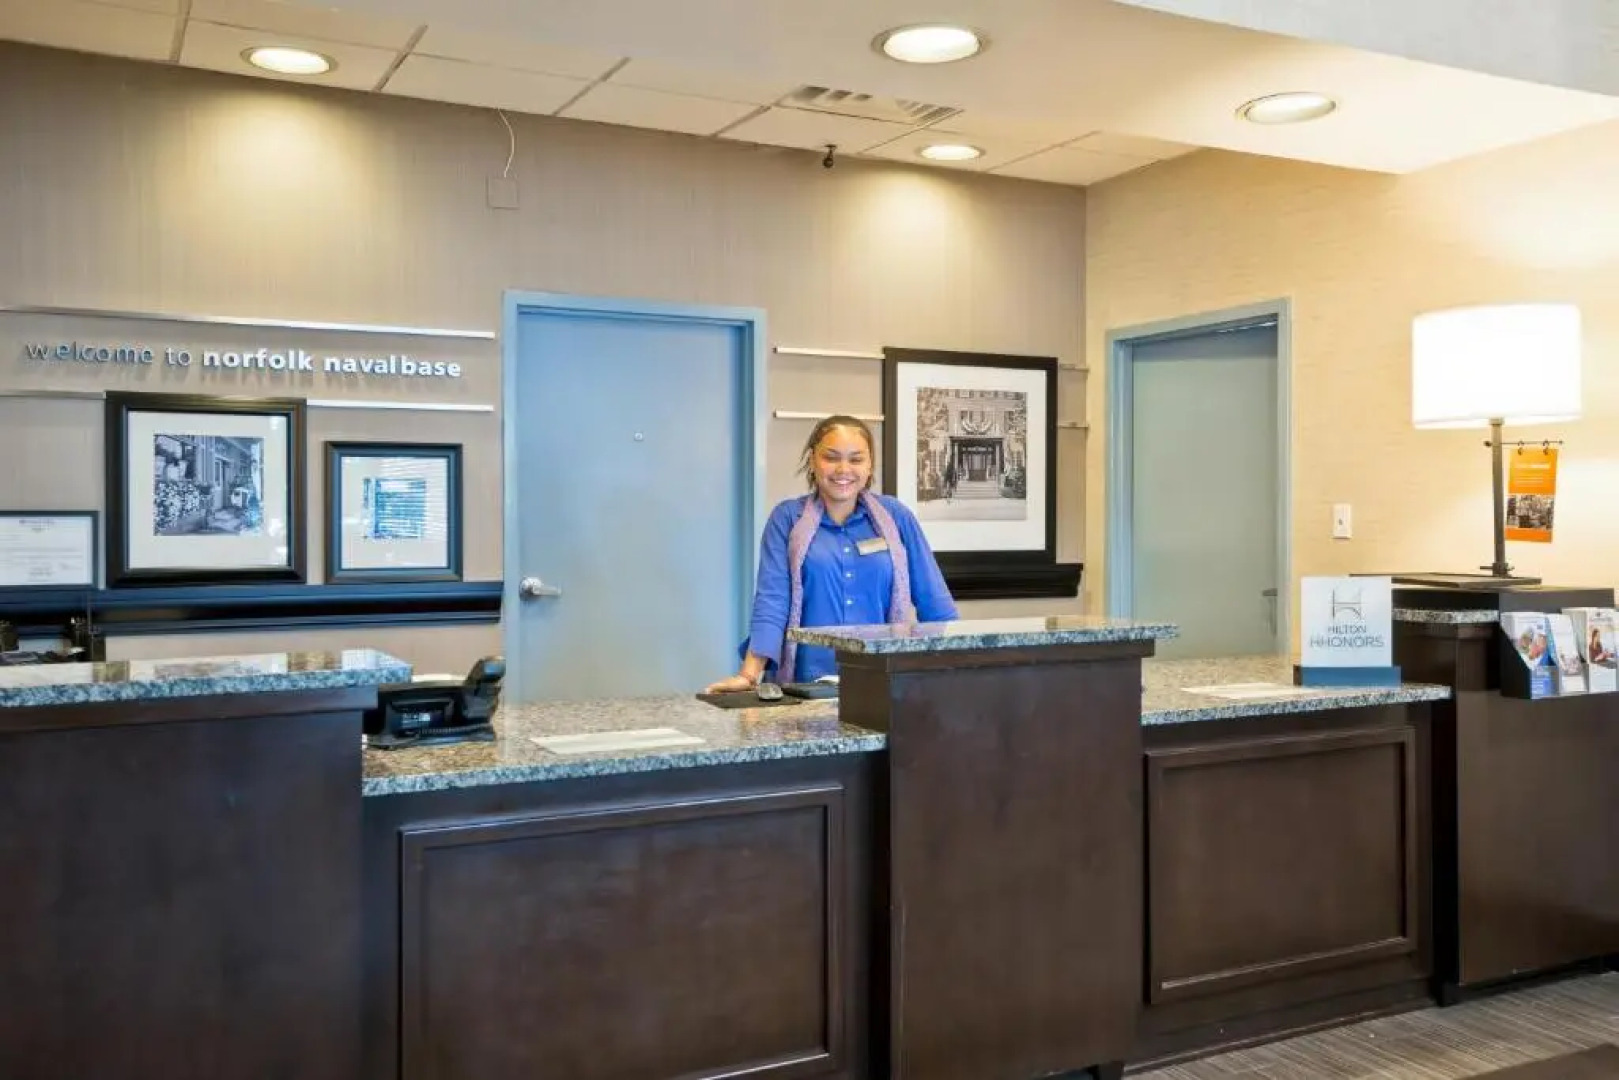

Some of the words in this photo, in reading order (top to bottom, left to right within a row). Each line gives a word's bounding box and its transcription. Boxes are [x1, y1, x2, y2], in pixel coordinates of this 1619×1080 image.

[26, 342, 153, 365] welcome
[165, 347, 192, 366] to
[202, 349, 314, 370] norfolk
[1327, 624, 1367, 635] HILTON
